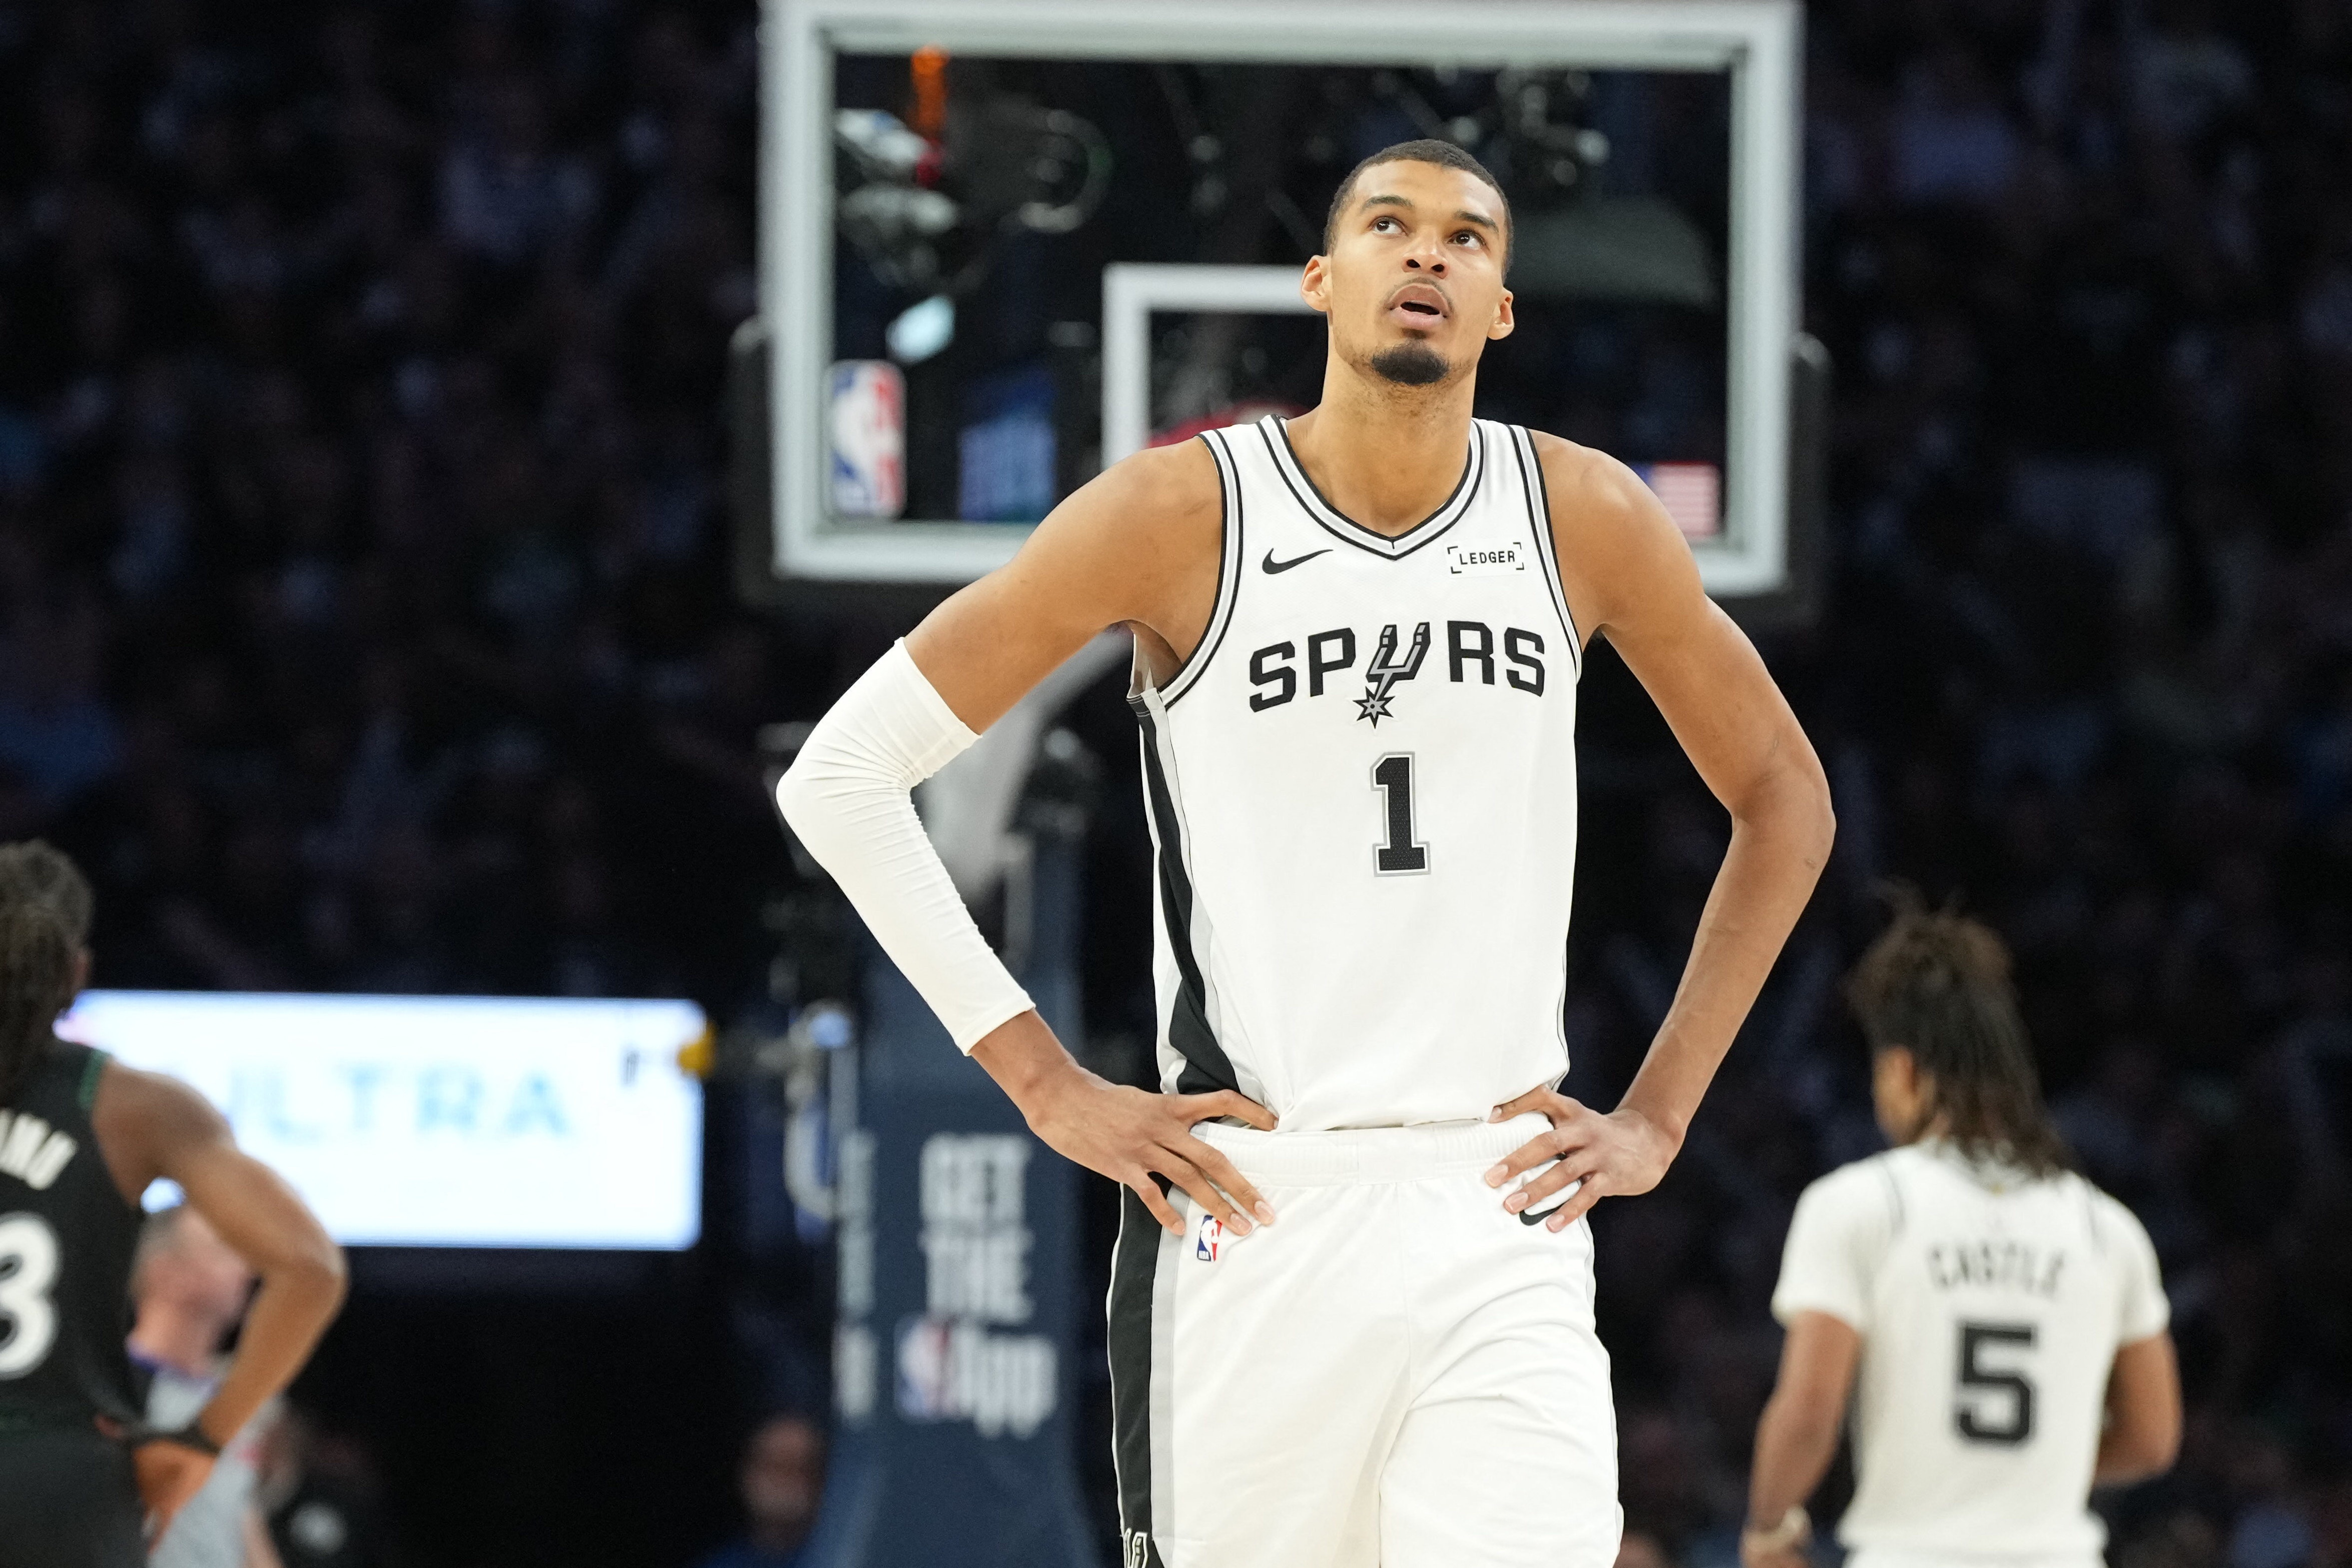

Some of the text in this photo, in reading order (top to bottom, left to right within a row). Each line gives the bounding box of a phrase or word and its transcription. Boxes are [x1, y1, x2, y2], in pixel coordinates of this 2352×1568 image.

[1459, 550, 1515, 565] LEDGER
[1249, 620, 1545, 729] SPURS
[1370, 751, 1432, 877] 1
[919, 1132, 1031, 1221] GET
[918, 1228, 1033, 1326] THE
[1198, 1250, 1209, 1260] NBA
[1928, 1239, 2065, 1297] CASTLE
[1957, 1319, 2037, 1447] 5
